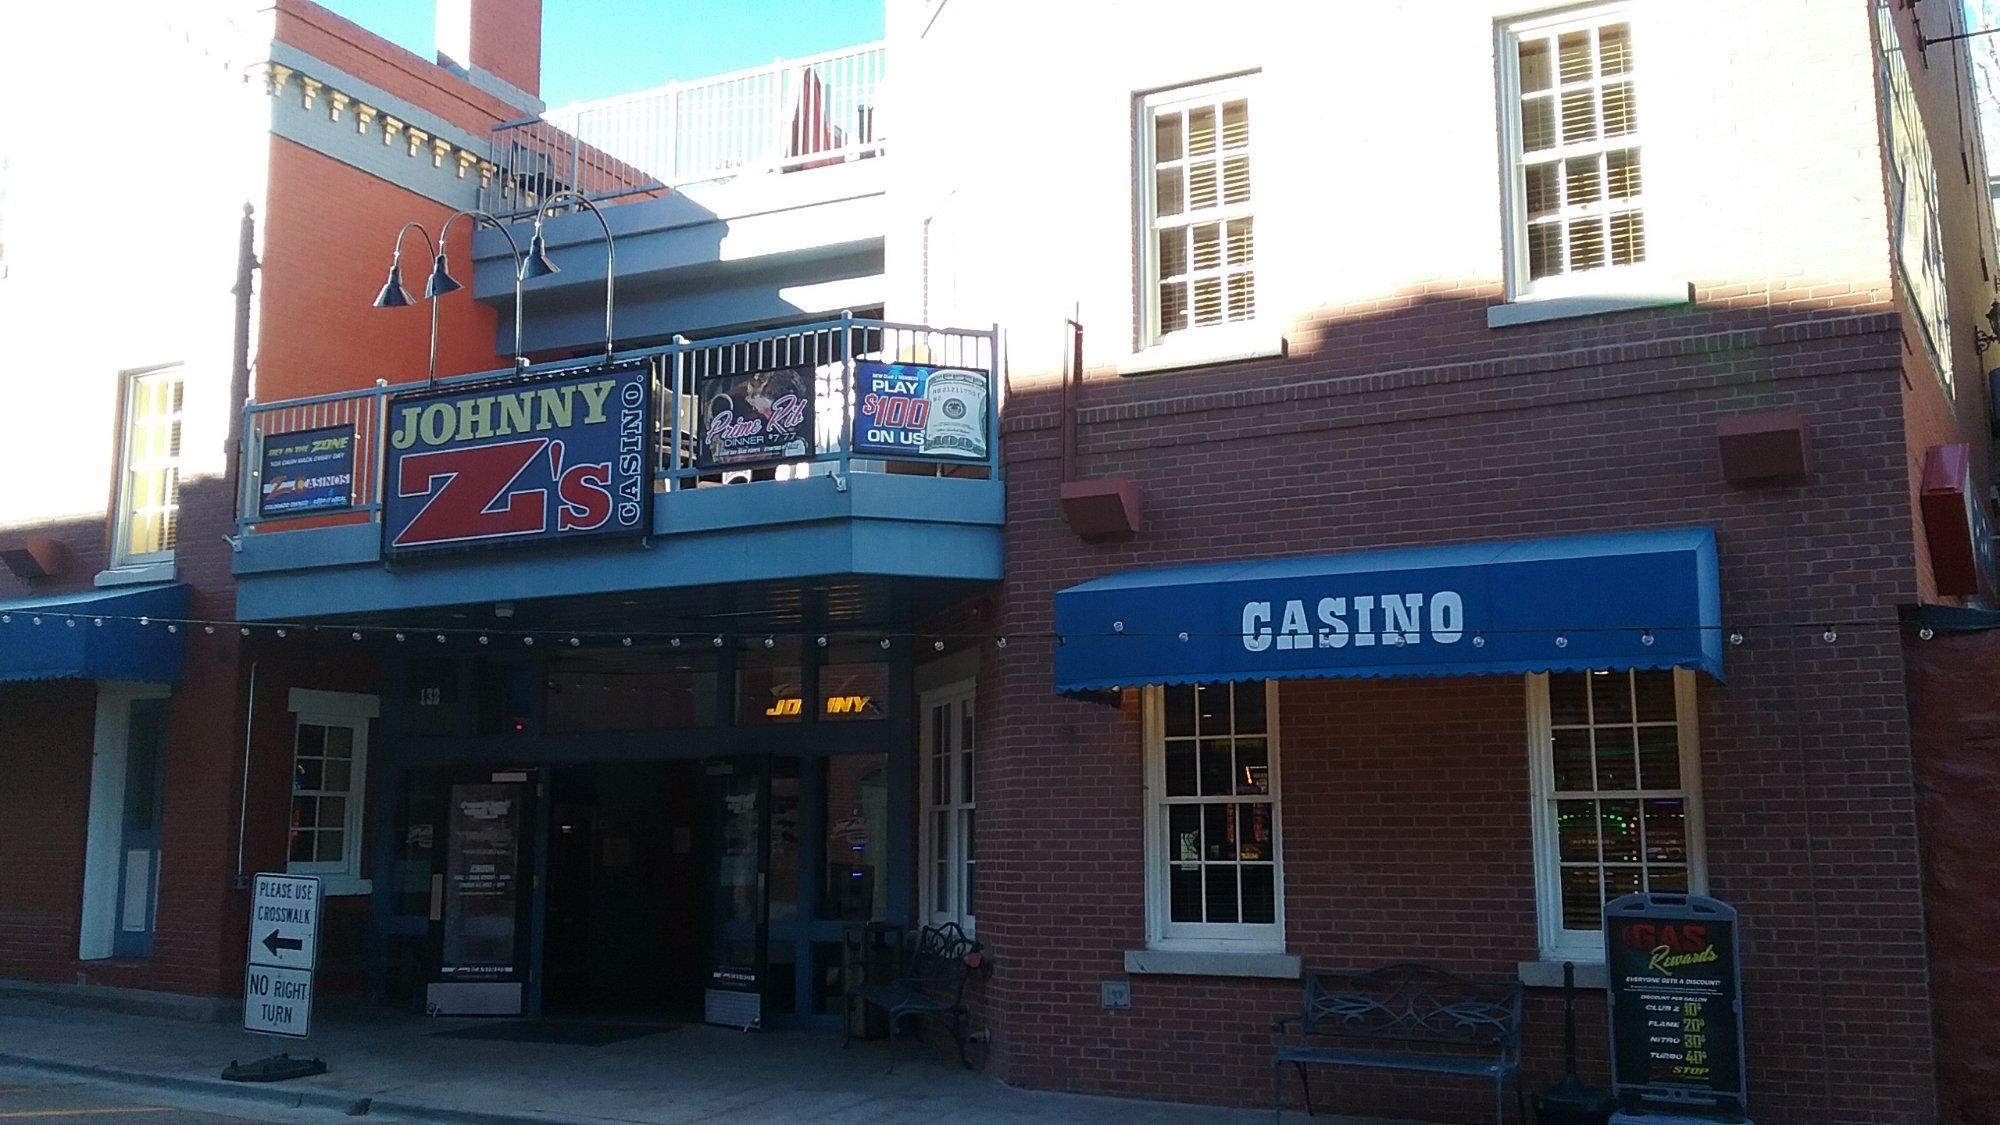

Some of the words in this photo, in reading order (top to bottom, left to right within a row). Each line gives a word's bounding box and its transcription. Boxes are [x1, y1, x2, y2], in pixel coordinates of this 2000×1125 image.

[872, 380, 919, 395] PLAY
[391, 382, 615, 450] JOHNNY
[705, 409, 763, 446] Prime
[767, 394, 809, 435] Rib
[862, 393, 931, 430] $100
[311, 437, 349, 453] ZONE
[724, 435, 765, 449] DINNER
[867, 430, 894, 443] ON
[900, 432, 926, 446] US
[393, 437, 613, 547] Z's
[1242, 590, 1464, 652] CASINO
[259, 882, 292, 899] PLEASE
[295, 885, 313, 901] USE
[258, 905, 311, 925] CROSSWALK
[1633, 923, 1707, 951] GAS
[1648, 944, 1718, 976] Rewards
[249, 974, 269, 996] NO
[274, 980, 307, 1000] RIGHT
[1626, 976, 1660, 984] EVERYONE
[1661, 977, 1678, 985] GETS
[261, 1004, 293, 1024] TURN
[1648, 1020, 1680, 1028] FLAME
[1650, 1036, 1681, 1044] NITRO
[1650, 1052, 1683, 1060] TURBO
[1672, 1066, 1709, 1075] STOP
